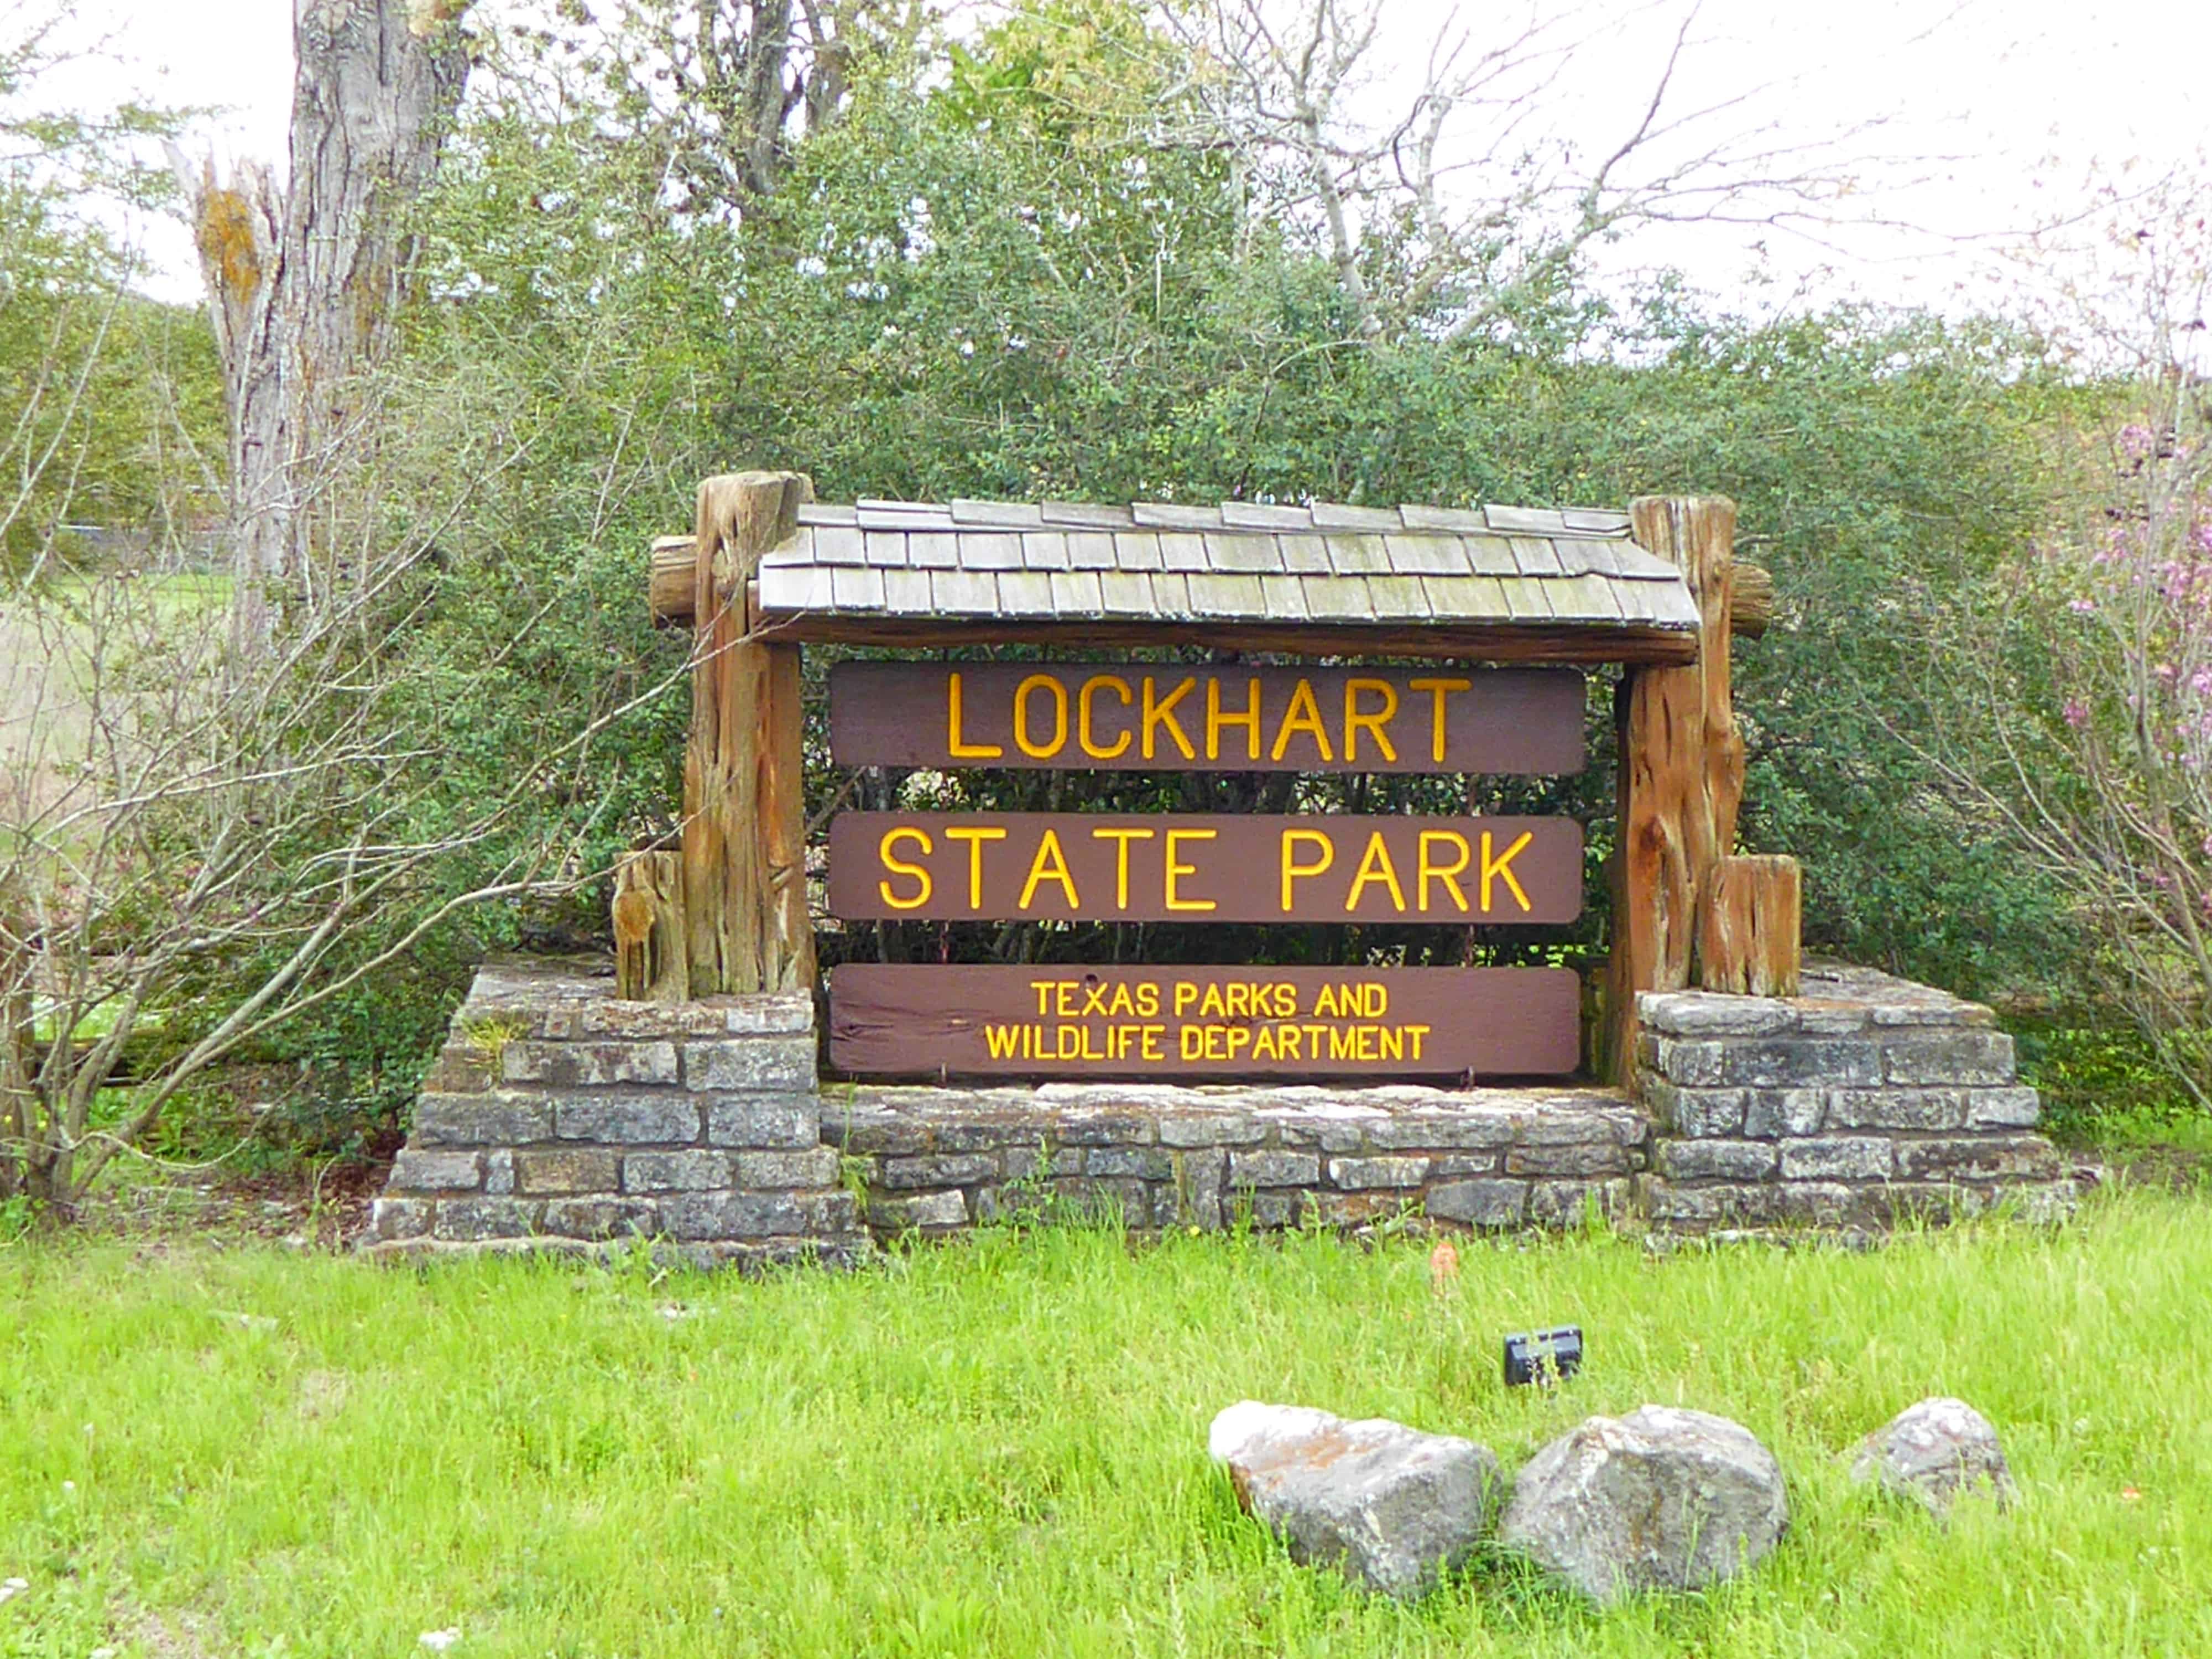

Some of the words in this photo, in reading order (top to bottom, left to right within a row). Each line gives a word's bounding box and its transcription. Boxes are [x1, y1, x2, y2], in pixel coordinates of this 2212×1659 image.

[949, 674, 1471, 763] LOCKHART
[879, 827, 1217, 911] STATE
[1280, 828, 1532, 913] PARK
[1029, 980, 1159, 1018] TEXAS
[1173, 981, 1298, 1019] PARKS
[1313, 982, 1388, 1019] AND
[984, 1024, 1165, 1063] WILDLIFE
[1179, 1023, 1431, 1062] DEPARTMENT
